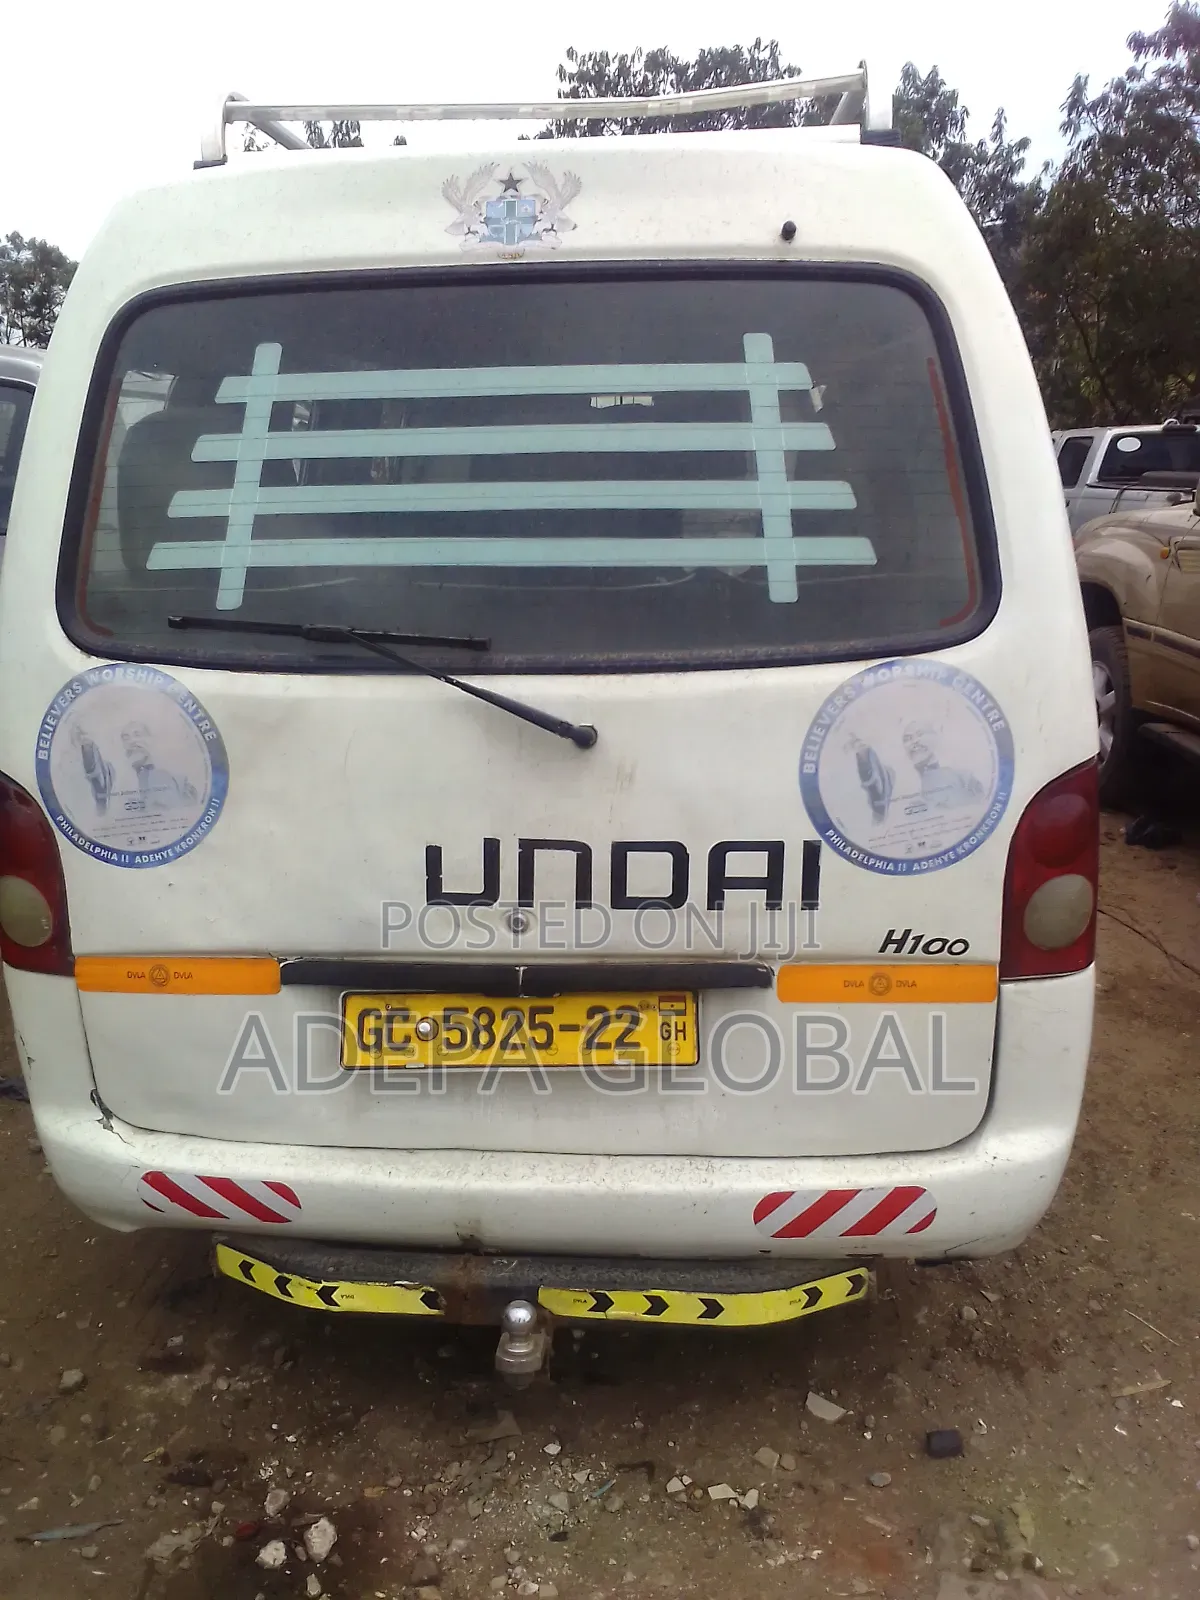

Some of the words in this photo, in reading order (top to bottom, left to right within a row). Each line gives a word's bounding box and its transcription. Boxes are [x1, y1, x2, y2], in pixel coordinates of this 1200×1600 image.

[38, 681, 83, 760] BELIEVERS
[85, 667, 165, 687] WORSHIP
[166, 683, 218, 742] CENTRE
[803, 684, 857, 774] BELIEVERS
[860, 664, 949, 689] WORSHIP
[951, 672, 1005, 732] CENTRE
[56, 814, 119, 861] PHILADELPHIA
[134, 848, 176, 865] ADEHYE
[175, 809, 217, 856] KRONKRON
[825, 829, 895, 872] PHILADELPHIA
[912, 851, 956, 872] ADEHYE
[956, 803, 1003, 855] KRONKRON
[425, 837, 820, 911] UNDAI
[878, 928, 970, 956] H100
[127, 971, 146, 979] DVLA
[173, 971, 193, 979] DVLA
[843, 980, 864, 988] DVLA
[895, 980, 917, 988] DVLA
[356, 1006, 412, 1052] GC
[442, 1004, 642, 1051] 5825-22
[660, 1021, 687, 1041] GH
